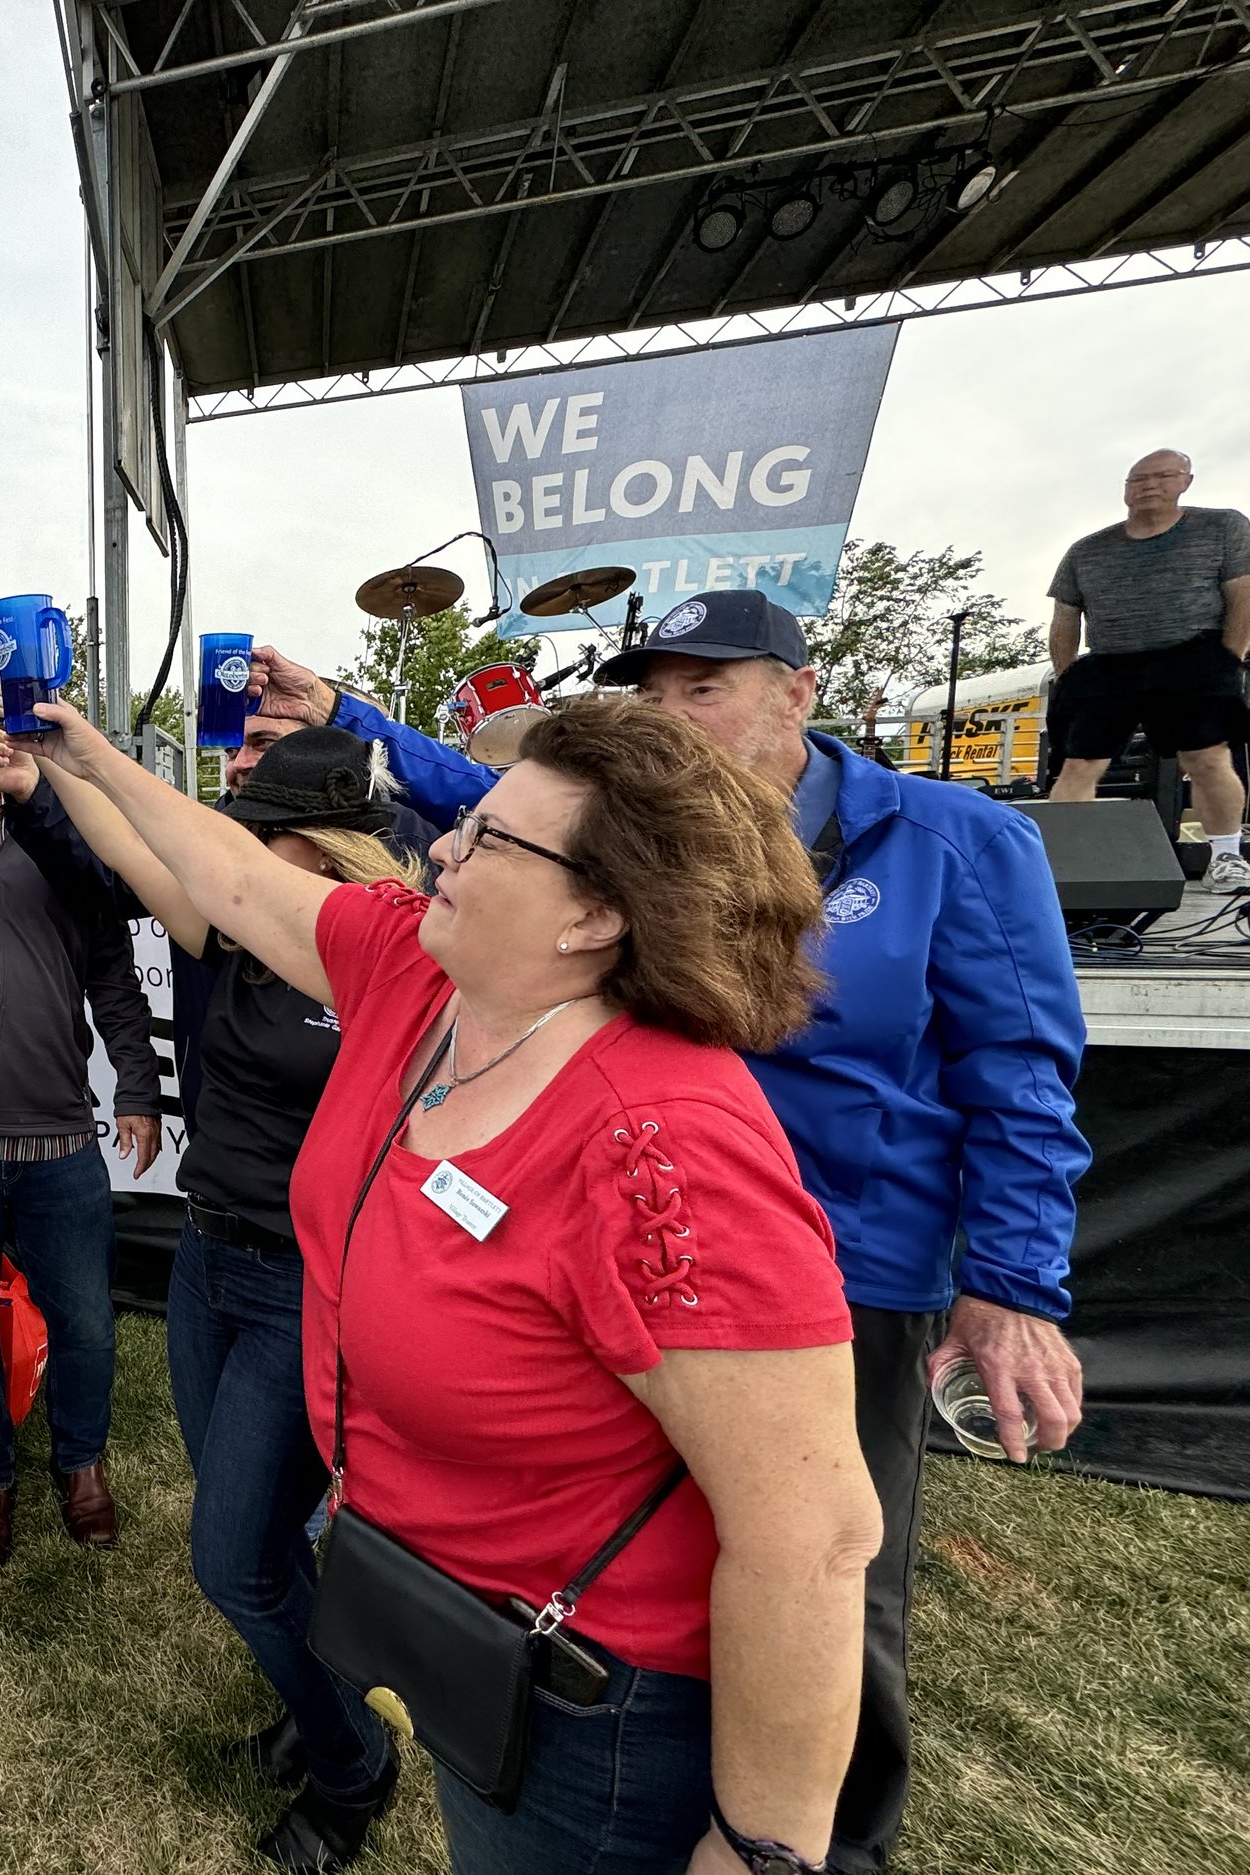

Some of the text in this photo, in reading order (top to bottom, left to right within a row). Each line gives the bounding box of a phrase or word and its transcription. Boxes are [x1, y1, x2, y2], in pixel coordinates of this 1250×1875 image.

[481, 391, 605, 463] WE
[491, 445, 812, 535] BELONG
[638, 552, 807, 593] TLETT
[963, 745, 999, 760] Rental
